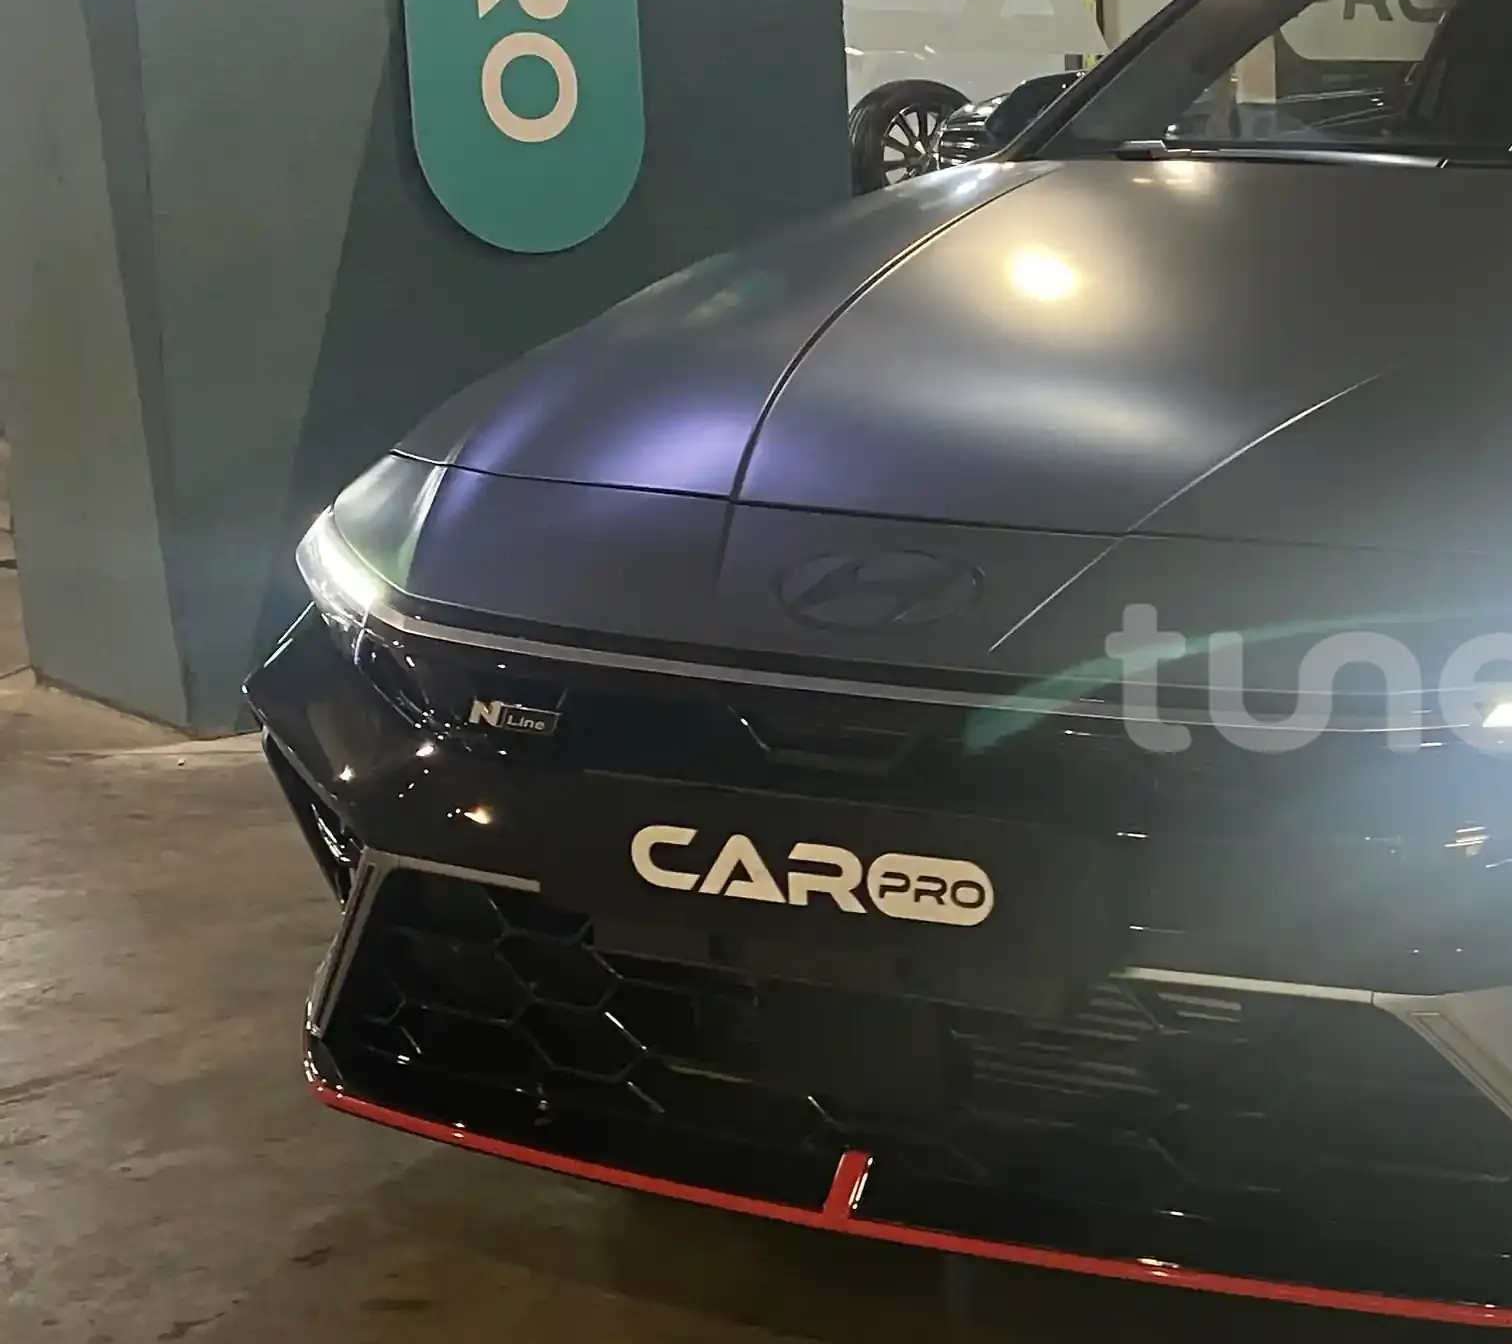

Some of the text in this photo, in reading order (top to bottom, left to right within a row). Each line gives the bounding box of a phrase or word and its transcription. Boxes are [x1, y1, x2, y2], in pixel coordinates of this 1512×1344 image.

[469, 700, 545, 730] N Line
[631, 825, 986, 914] CAR PRO
